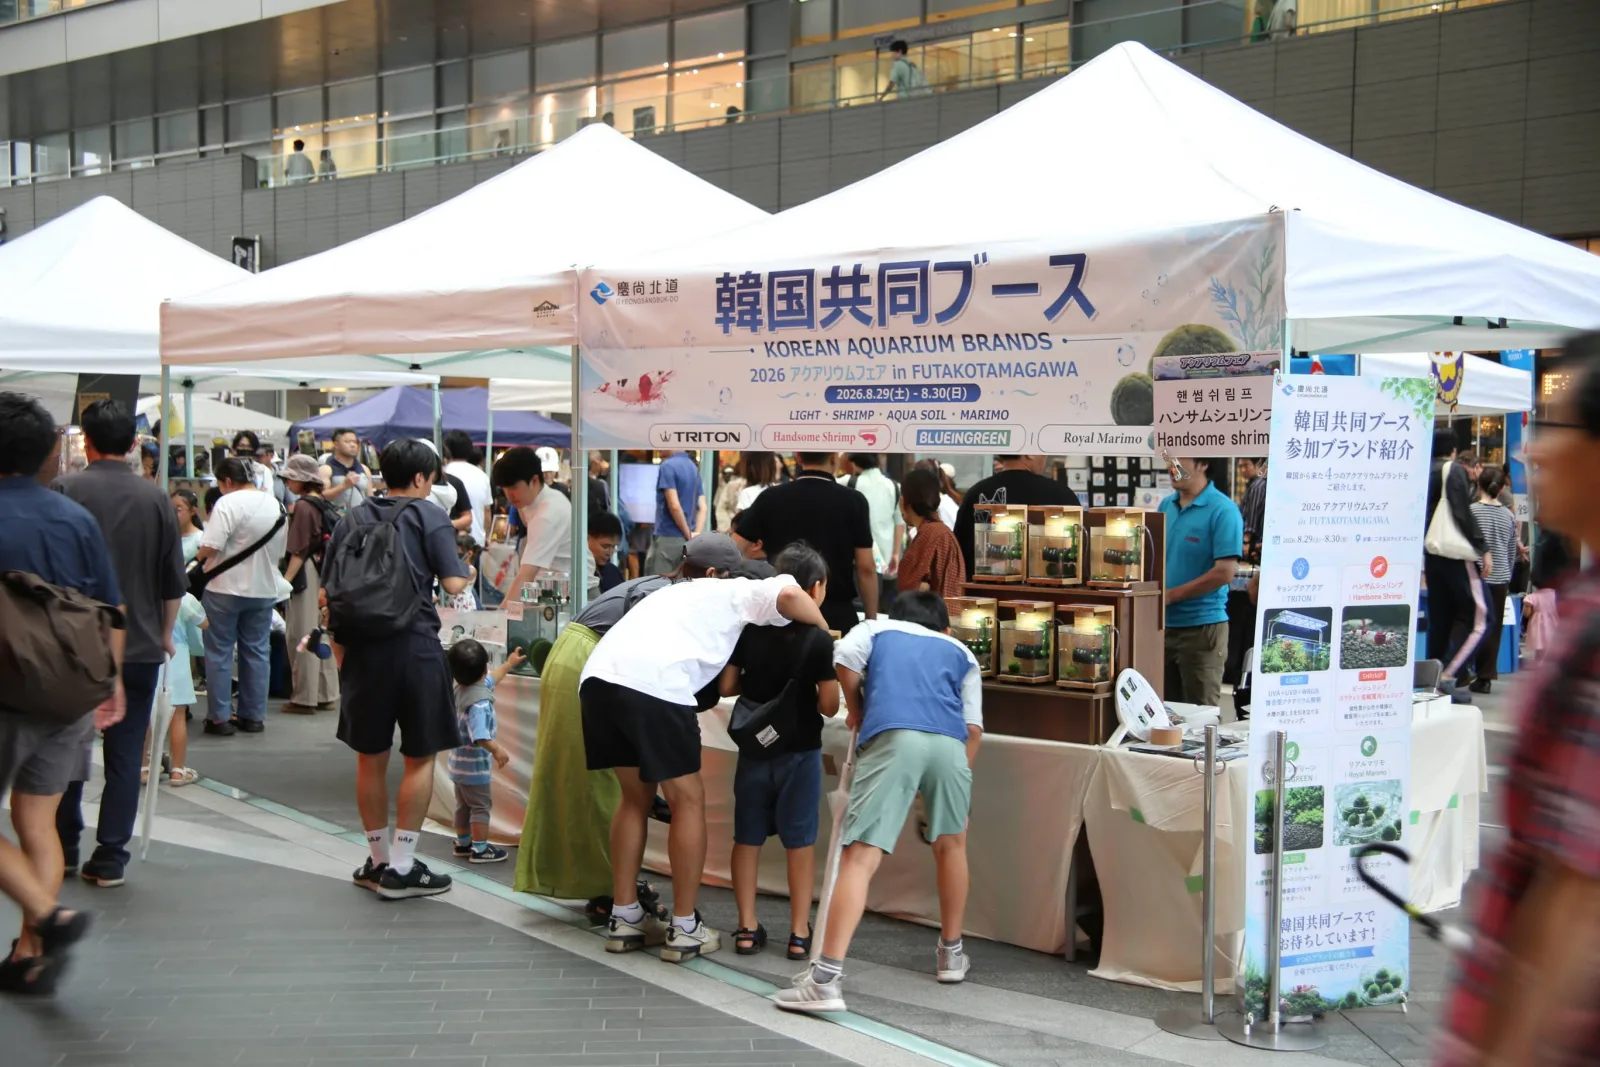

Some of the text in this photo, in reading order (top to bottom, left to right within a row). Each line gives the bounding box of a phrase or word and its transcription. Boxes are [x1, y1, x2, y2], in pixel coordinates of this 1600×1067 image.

[617, 278, 679, 296] 慶尚北道
[714, 252, 1097, 334] 韓国共同ブース
[764, 332, 1053, 358] KOREAN AQUARIUM BRANDS
[750, 360, 1078, 383] 2026 アクアリウムフェア in FUTAKOTAMAGAWA
[836, 387, 910, 402] 2026.8.29(土)
[921, 386, 967, 401] 8.30(日)
[789, 409, 1010, 421] LIGHT SHRIMP AQUA SOIL MARIMO
[1294, 410, 1411, 433] 韓国共同ブース
[673, 431, 741, 443] TRITON
[773, 431, 856, 445] Handsome Shrimp
[918, 431, 1007, 445] BLUEINGREEN
[1063, 432, 1143, 445] Royal Marimo
[1157, 429, 1270, 447] Handsome shrim
[1285, 438, 1414, 461] 参加ブランド紹介
[1301, 502, 1389, 512] 2026 アクアリウムフェア
[1309, 516, 1390, 525] FUTAKOTAMAGAWA
[1281, 910, 1375, 933] 韓国共同ブースで
